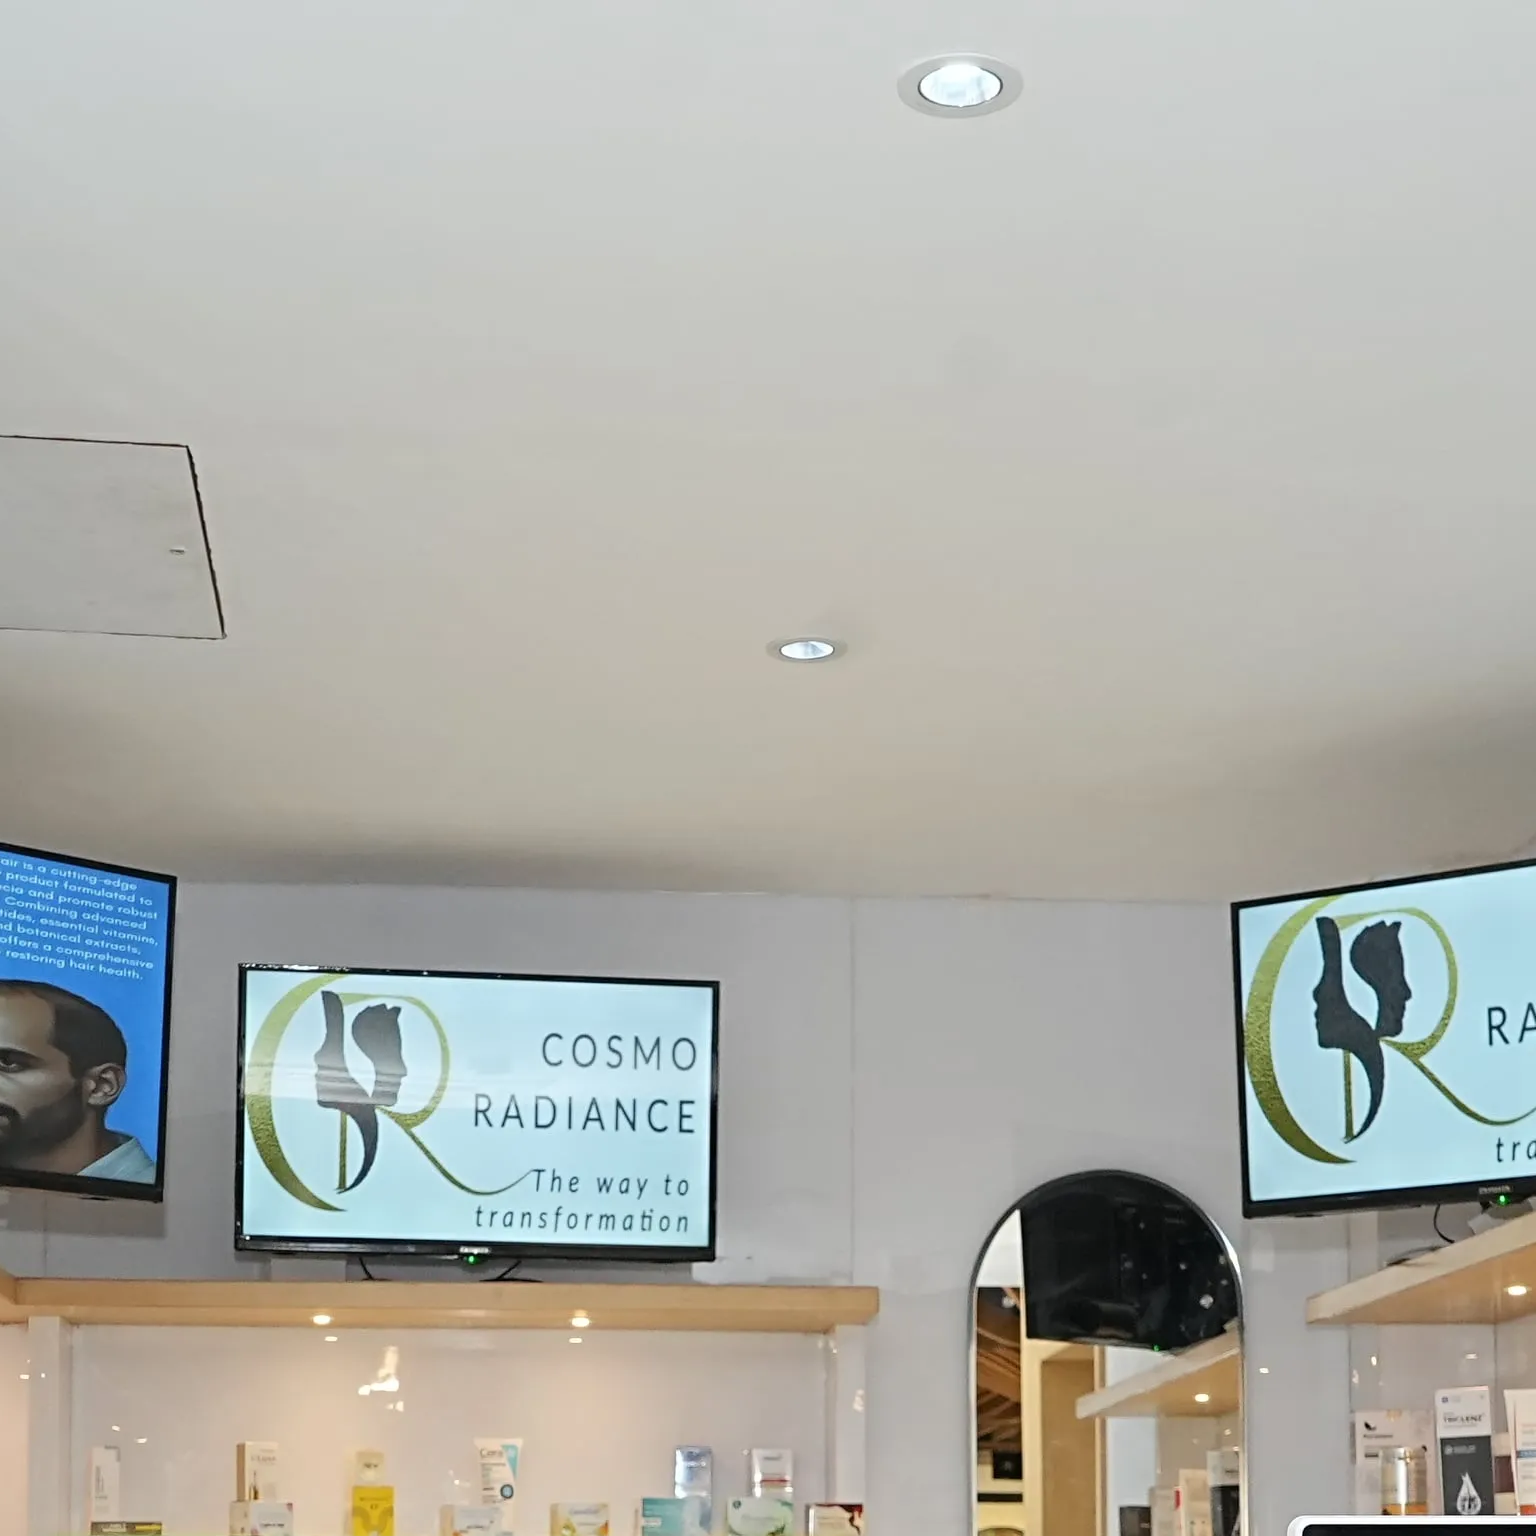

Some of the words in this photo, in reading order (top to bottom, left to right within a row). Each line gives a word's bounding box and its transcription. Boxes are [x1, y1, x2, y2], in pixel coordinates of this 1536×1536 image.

[6, 873, 59, 889] product
[64, 883, 135, 903] formulated
[140, 897, 153, 906] to
[23, 861, 33, 870] is
[51, 867, 137, 891] cutting-edge
[5, 896, 77, 919] Combining
[82, 911, 147, 930] advanced
[28, 889, 54, 900] and
[58, 894, 113, 912] promote
[117, 905, 158, 920] robust
[17, 923, 81, 944] botanical
[85, 937, 141, 955] extracts,
[40, 917, 98, 934] essential
[103, 929, 158, 946] vitamins,
[0, 934, 38, 949] offers
[56, 946, 153, 970] comprehensive
[6, 949, 65, 968] restoring
[70, 960, 94, 971] hair
[99, 965, 143, 980] health.
[543, 1033, 696, 1071] COSMO
[474, 1093, 695, 1133] RADIANCE
[531, 1169, 579, 1193] The
[596, 1177, 648, 1199] way
[664, 1172, 689, 1195] to
[476, 1205, 689, 1233] transformation
